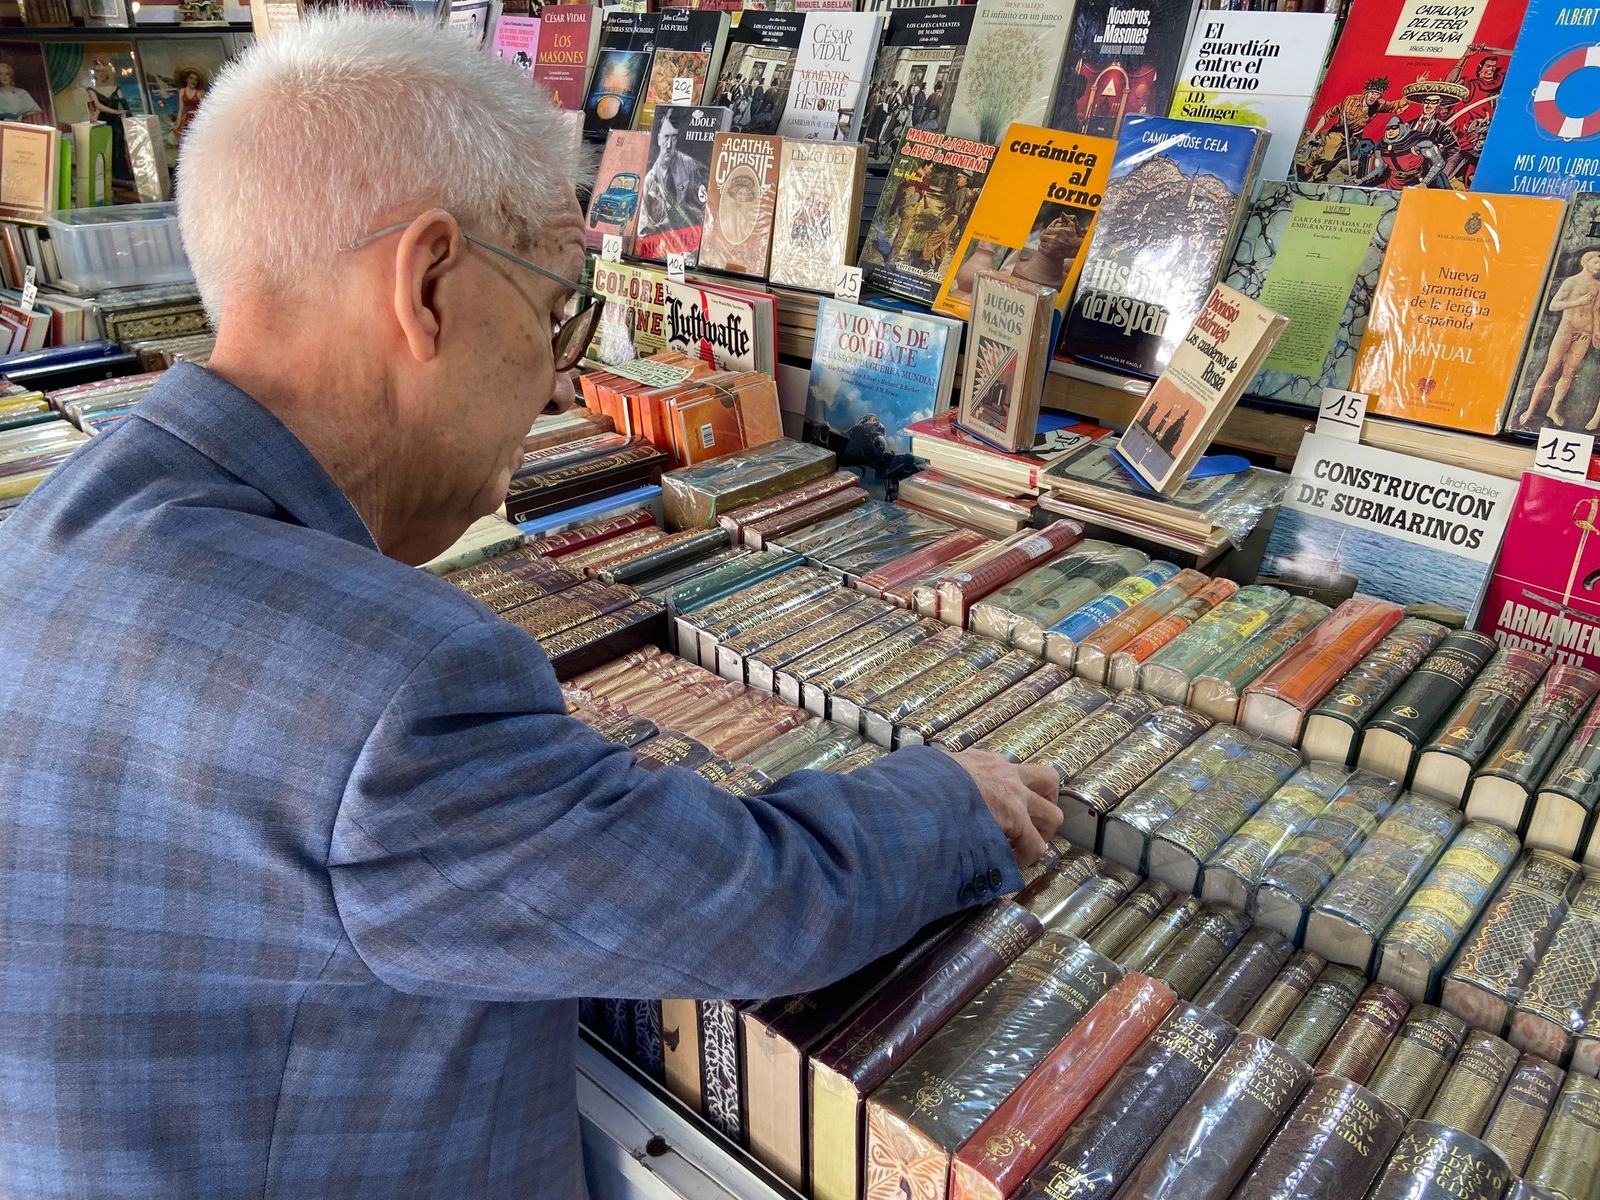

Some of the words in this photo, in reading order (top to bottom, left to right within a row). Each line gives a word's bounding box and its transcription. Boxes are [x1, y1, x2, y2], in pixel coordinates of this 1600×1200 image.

[545, 12, 565, 23] CÉSAR
[567, 13, 587, 23] VIDAL
[982, 10, 990, 18] El
[990, 10, 1017, 20] infinito
[1039, 12, 1063, 23] junco
[1107, 7, 1151, 26] Nosotros,
[1415, 5, 1475, 18] CATALOGO
[670, 24, 689, 32] FURIAS
[813, 23, 853, 45] CÉSAR
[1204, 23, 1225, 40] El
[1407, 18, 1428, 29] DEL
[1427, 18, 1468, 31] TEBEO
[554, 33, 572, 48] LOS
[1102, 25, 1148, 44] Masones
[1398, 31, 1415, 41] EN
[1416, 30, 1464, 44] ESPAÑA
[539, 51, 584, 64] MASONES
[812, 44, 851, 62] VIDAL
[1199, 39, 1281, 58] guardián
[801, 69, 850, 82] MOMENTOS
[1195, 58, 1242, 74] entre
[1245, 58, 1262, 75] el
[797, 80, 848, 97] CUMBRE
[1190, 74, 1259, 91] centeno
[1184, 92, 1206, 104] J.D.
[1180, 104, 1239, 121] Salinger
[689, 117, 716, 128] ADOLF
[685, 131, 715, 141] HITLER
[906, 128, 944, 147] MANUAL
[955, 139, 996, 159] CAZADOR
[1204, 138, 1229, 153] CELA
[722, 138, 773, 154] AGATHA
[1009, 140, 1098, 168] cerámica
[716, 151, 775, 184] CHRISTIE
[827, 151, 847, 165] DEL
[901, 142, 911, 155] de
[910, 144, 934, 160] AVES
[933, 150, 944, 163] de
[943, 152, 988, 174] MONTAÑA
[1514, 155, 1534, 172] MIS
[1540, 155, 1560, 173] DOS
[1068, 167, 1091, 187] al
[1046, 182, 1102, 207] torno
[1291, 223, 1337, 232] EMIGRANTES
[1344, 227, 1372, 235] INDIAS
[1293, 216, 1322, 224] CARTAS
[1323, 218, 1360, 228] PRIVADAS
[1362, 221, 1373, 229] DE
[837, 271, 859, 293] 15
[1439, 267, 1480, 283] Nueva
[1422, 282, 1487, 300] gramática
[984, 292, 1025, 318] JUEGOS
[1082, 291, 1102, 319] de
[1206, 289, 1240, 323] Dionisio
[1410, 296, 1428, 310] de
[1431, 297, 1442, 310] la
[1445, 299, 1490, 320] lengua
[666, 296, 750, 358] Luftwaffe
[833, 311, 903, 343] AVIONES
[906, 328, 930, 350] DE
[982, 310, 1022, 335] MANOS
[1417, 314, 1474, 332] española
[839, 332, 918, 368] COMBATE
[1185, 327, 1199, 346] Los
[1197, 339, 1227, 368] cuadernos
[1226, 356, 1238, 373] de
[1404, 338, 1476, 365] MANUAL
[869, 361, 901, 377] GUERRA
[1200, 360, 1226, 392] Rusia
[1326, 395, 1362, 419] 15
[1541, 437, 1581, 462] 15
[1313, 458, 1496, 521] CONSTRUCCION
[1440, 475, 1467, 492] Ulrich
[1467, 481, 1501, 498] Gabler
[1297, 483, 1329, 508] DE
[1330, 492, 1484, 550] SUBMARINOS
[1170, 1020, 1216, 1052] WILDE
[1178, 1017, 1217, 1044] OSCAR
[1168, 1031, 1206, 1056] OBRAS
[1151, 1035, 1211, 1072] COMPLETAS
[1323, 1107, 1365, 1136] ORAS
[1426, 1136, 1502, 1190] PALACIO
